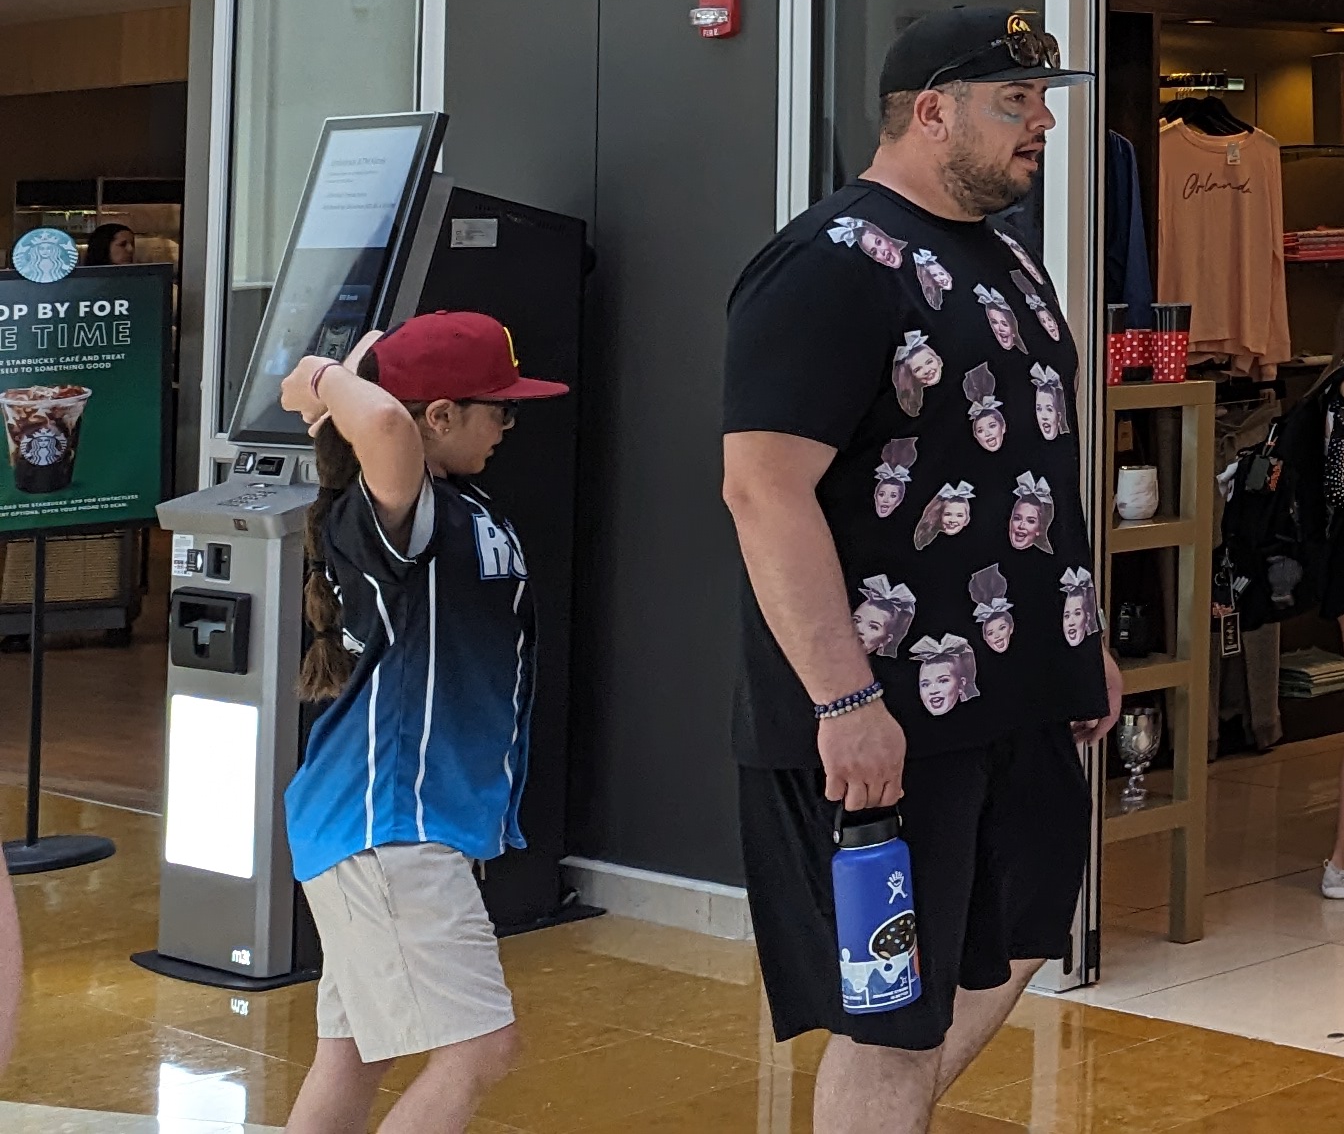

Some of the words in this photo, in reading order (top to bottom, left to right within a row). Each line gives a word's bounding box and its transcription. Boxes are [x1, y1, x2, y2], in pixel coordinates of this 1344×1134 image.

[38, 302, 70, 319] BY
[79, 300, 129, 317] FOR
[32, 321, 131, 348] TIME
[82, 354, 99, 362] AND
[35, 364, 84, 372] SOMETHING
